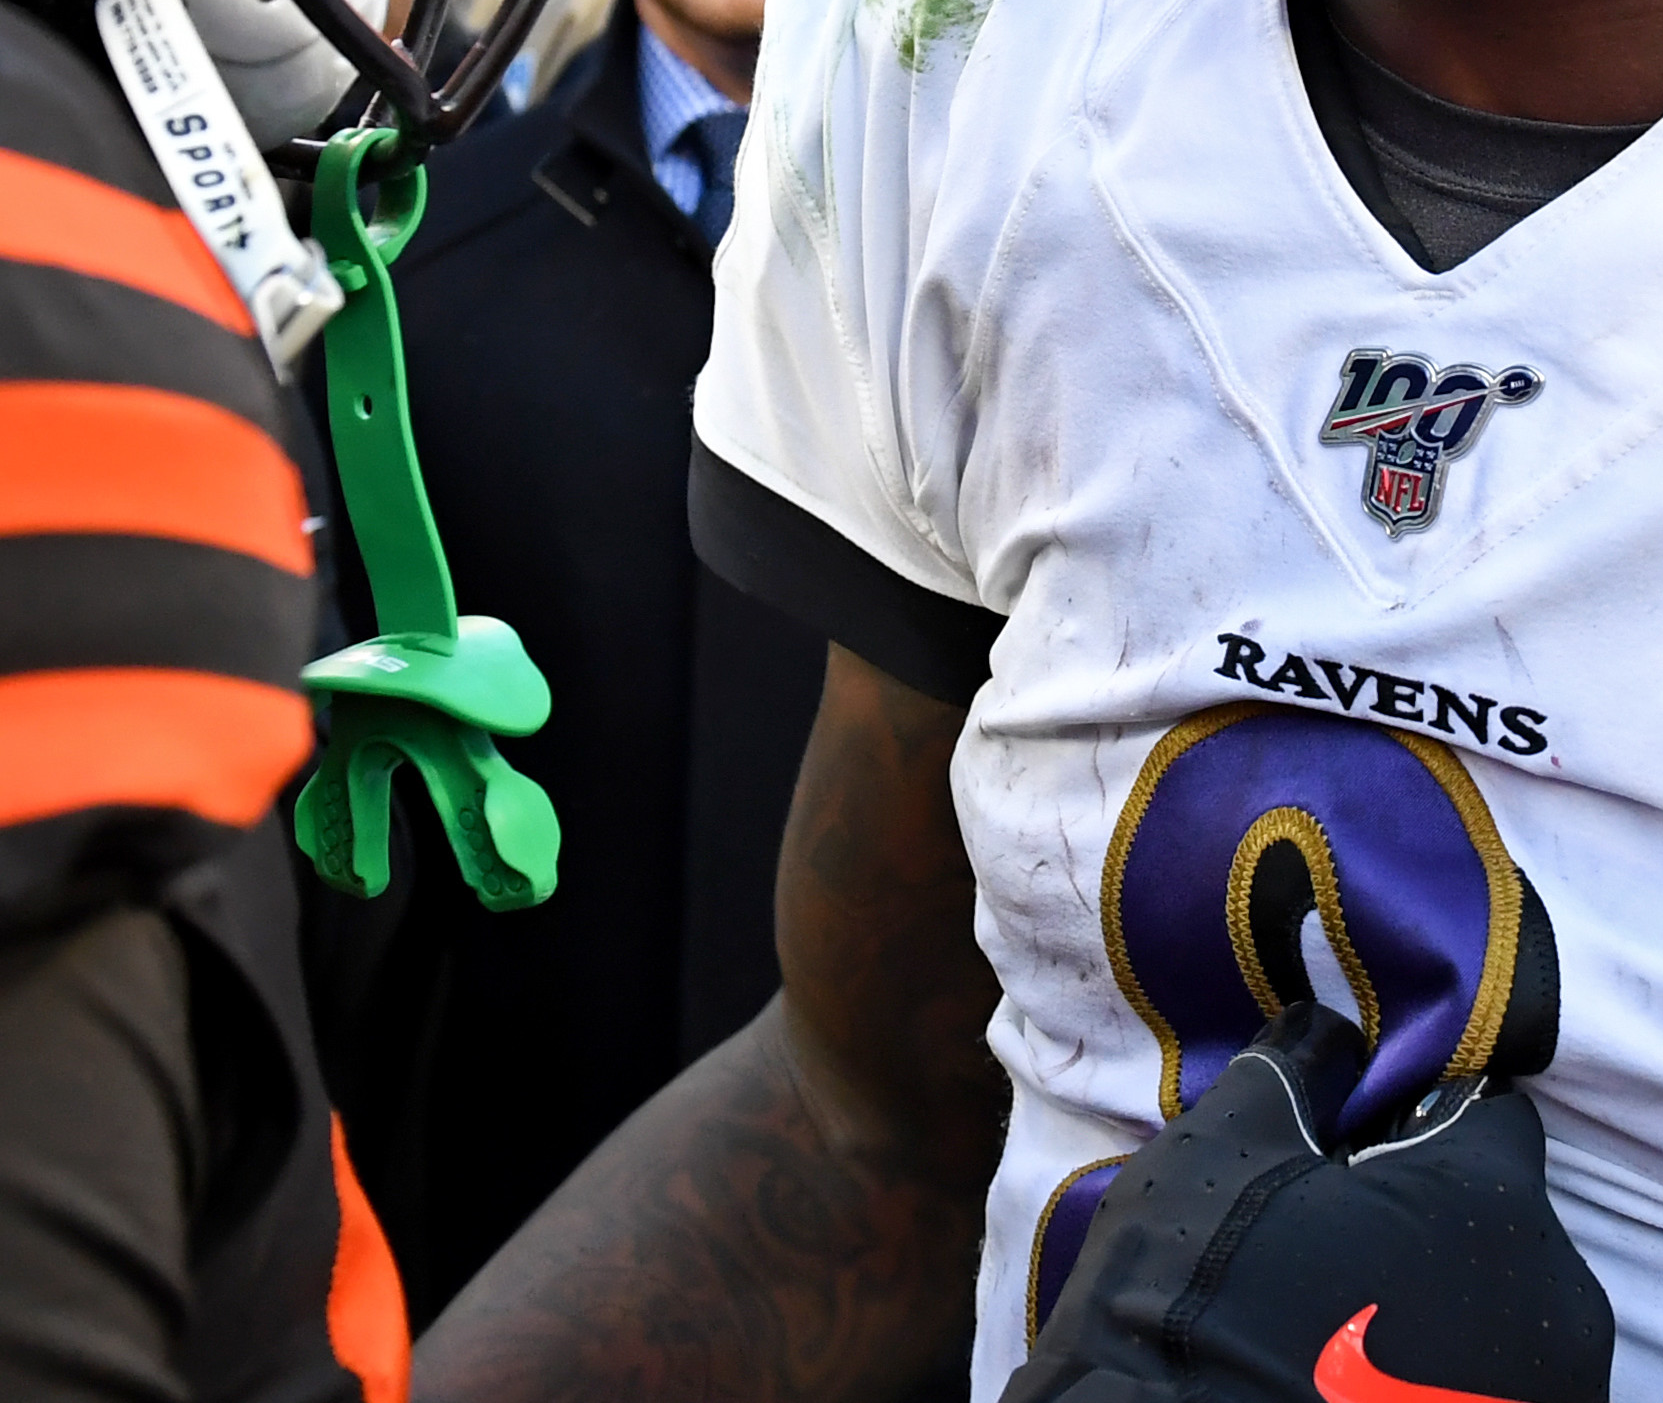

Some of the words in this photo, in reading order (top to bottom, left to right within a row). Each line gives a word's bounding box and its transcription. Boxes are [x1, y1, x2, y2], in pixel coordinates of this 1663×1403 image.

[1338, 357, 1492, 453] 100
[1374, 466, 1427, 514] NFL
[1212, 631, 1550, 756] RAVENS
